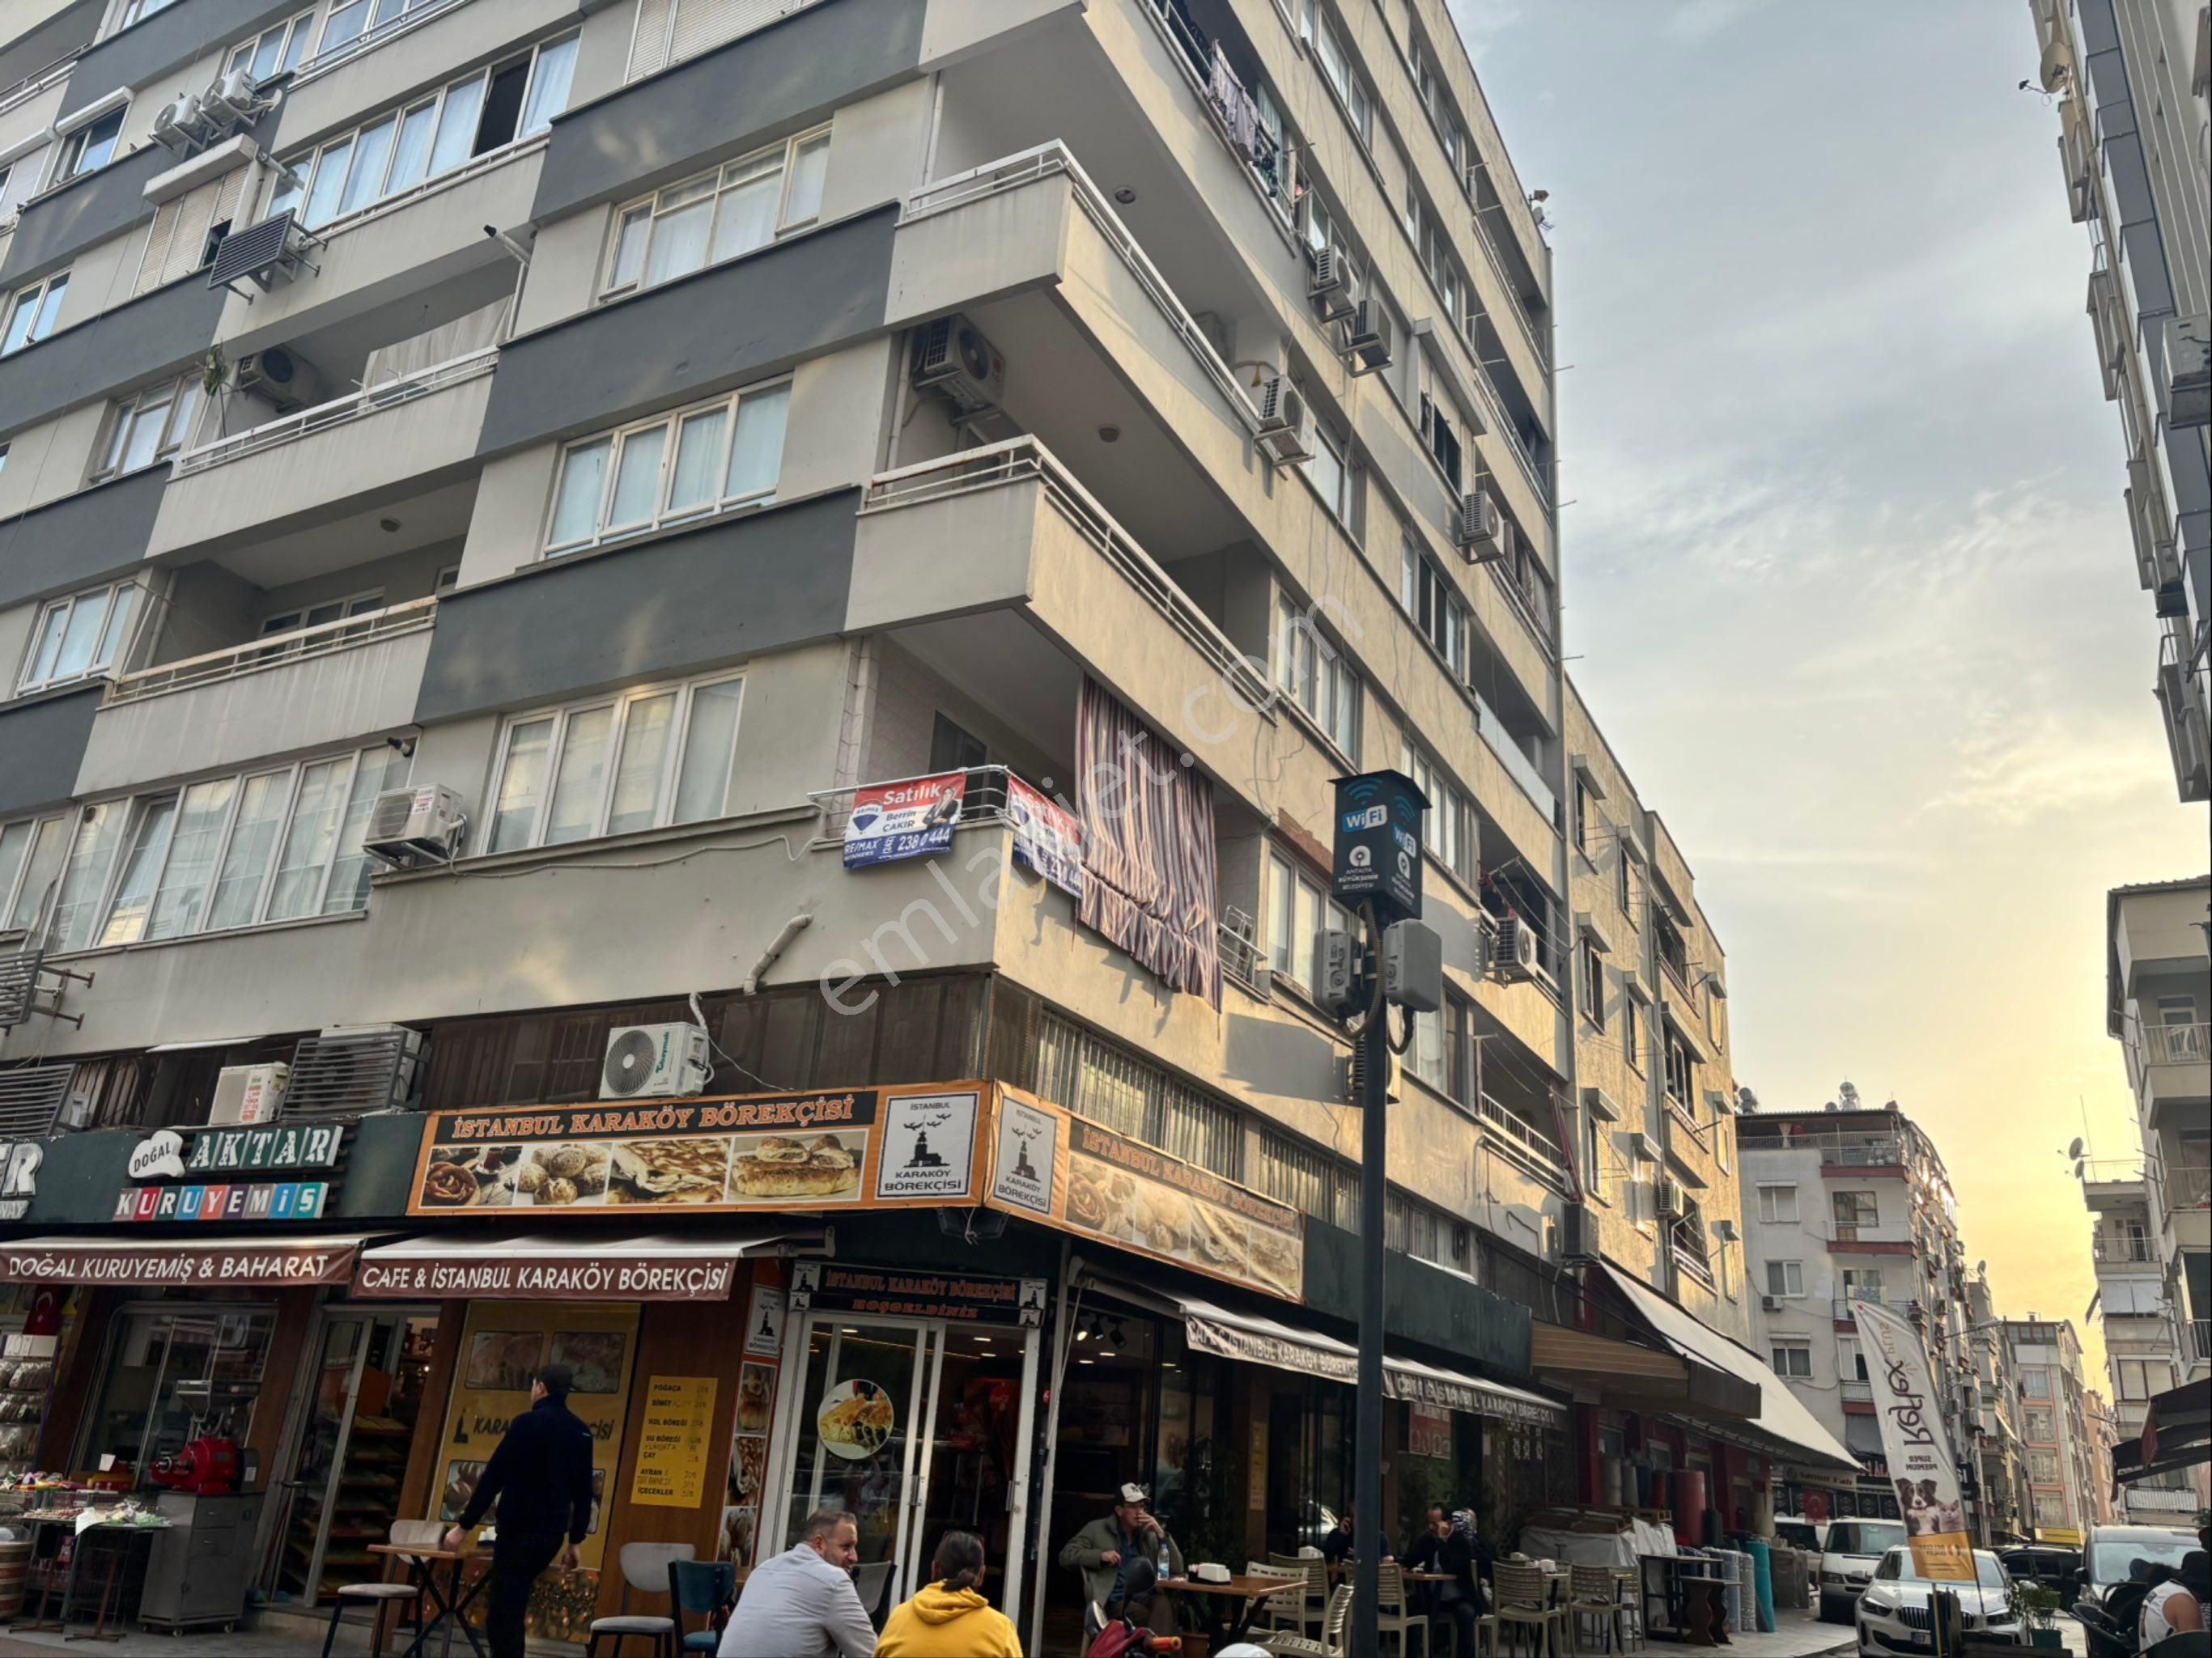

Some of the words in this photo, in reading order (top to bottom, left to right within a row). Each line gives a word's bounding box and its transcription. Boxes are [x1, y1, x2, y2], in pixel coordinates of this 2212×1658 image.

[883, 782, 941, 805] Satılık
[886, 810, 916, 821] Berrin
[1346, 808, 1382, 829] WiFi
[844, 841, 878, 855] RE/MAX
[897, 834, 920, 851] 238
[929, 827, 951, 844] 444
[452, 1114, 565, 1139] İSTANBUL
[569, 1105, 694, 1134] KARAKÖY
[699, 1094, 856, 1128] BÖREKÇİSİ
[910, 1101, 951, 1111] İSTANBUL
[134, 1141, 172, 1173] DOĞAL
[189, 1128, 332, 1168] AKTAR
[1082, 1125, 1160, 1177] İSTANBUL
[885, 1179, 962, 1192] BÖREKÇİSİ
[895, 1168, 952, 1179] KARAKÖY
[1004, 1175, 1042, 1193] KARAKÖY
[997, 1184, 1047, 1208] BÖREKÇİSİ
[8, 1253, 76, 1278] DOĞAL
[81, 1253, 195, 1284] KURUYEMİŞ
[198, 1257, 214, 1278] &
[219, 1255, 329, 1278] BAHARAT
[363, 1267, 410, 1288] CAFE
[414, 1268, 427, 1288] &
[431, 1262, 512, 1290] İSTANBUL
[516, 1262, 615, 1290] KARAKÖY
[618, 1262, 730, 1297] BÖREKÇİSİ
[825, 1270, 885, 1291] İSTANBUL
[887, 1274, 948, 1296] KARAKÖY
[640, 1468, 663, 1476] AYRAN
